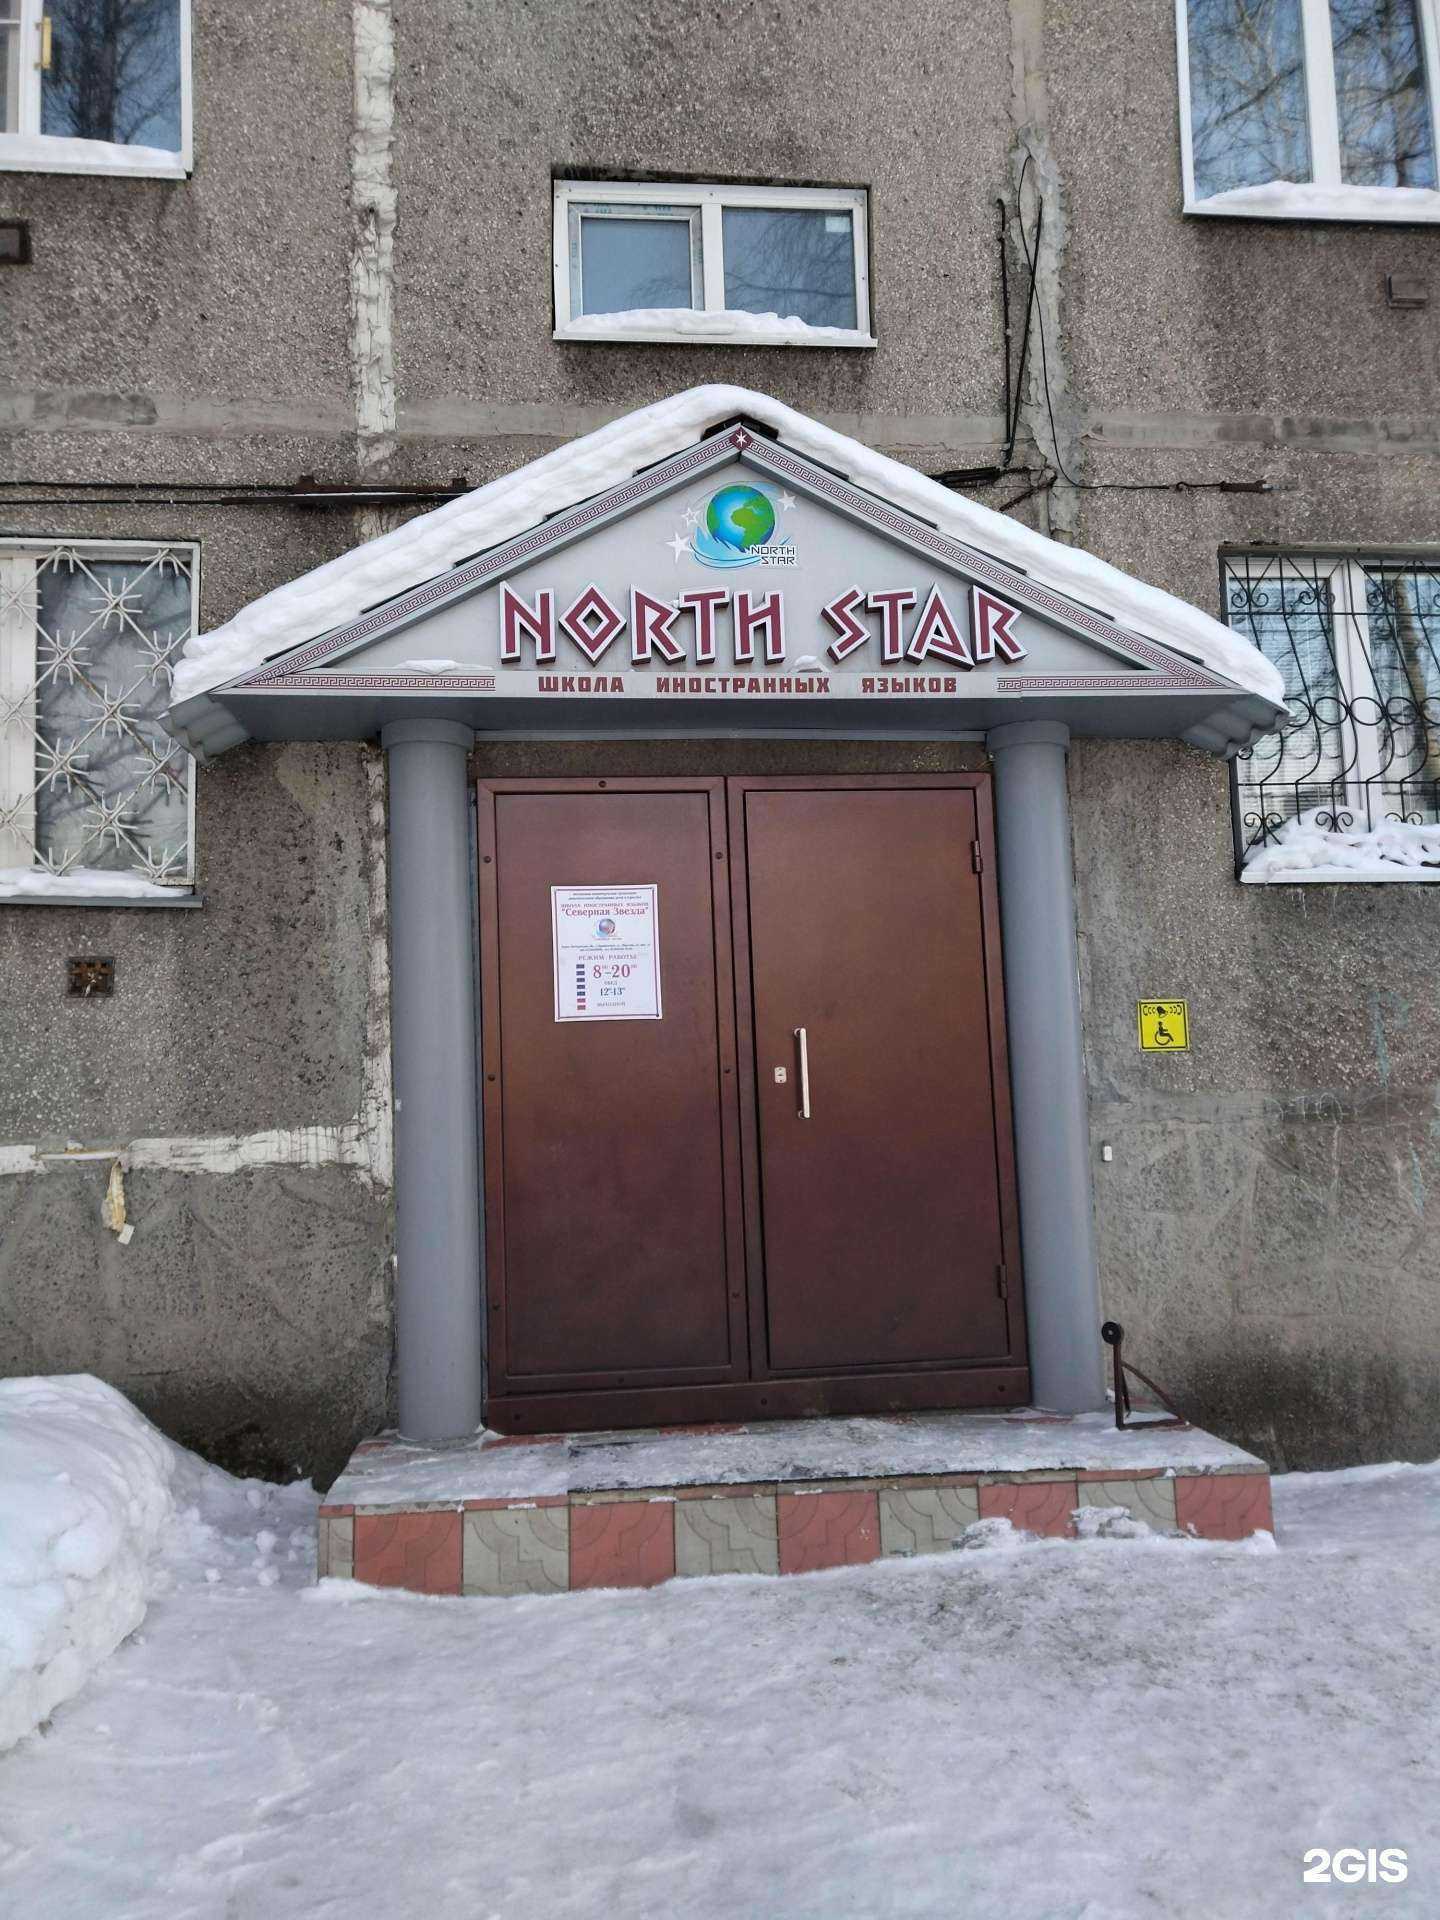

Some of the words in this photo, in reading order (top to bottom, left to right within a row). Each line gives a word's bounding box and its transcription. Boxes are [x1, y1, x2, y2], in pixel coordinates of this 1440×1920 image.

[751, 546, 795, 555] NORTH
[761, 556, 795, 565] STAR
[499, 580, 785, 665] NORTH
[821, 582, 1028, 671] STAR
[538, 676, 625, 693] ШКОЛА
[656, 676, 830, 693] ИНОСТРАННЫХ
[862, 677, 957, 693] ЯЗЫКОВ
